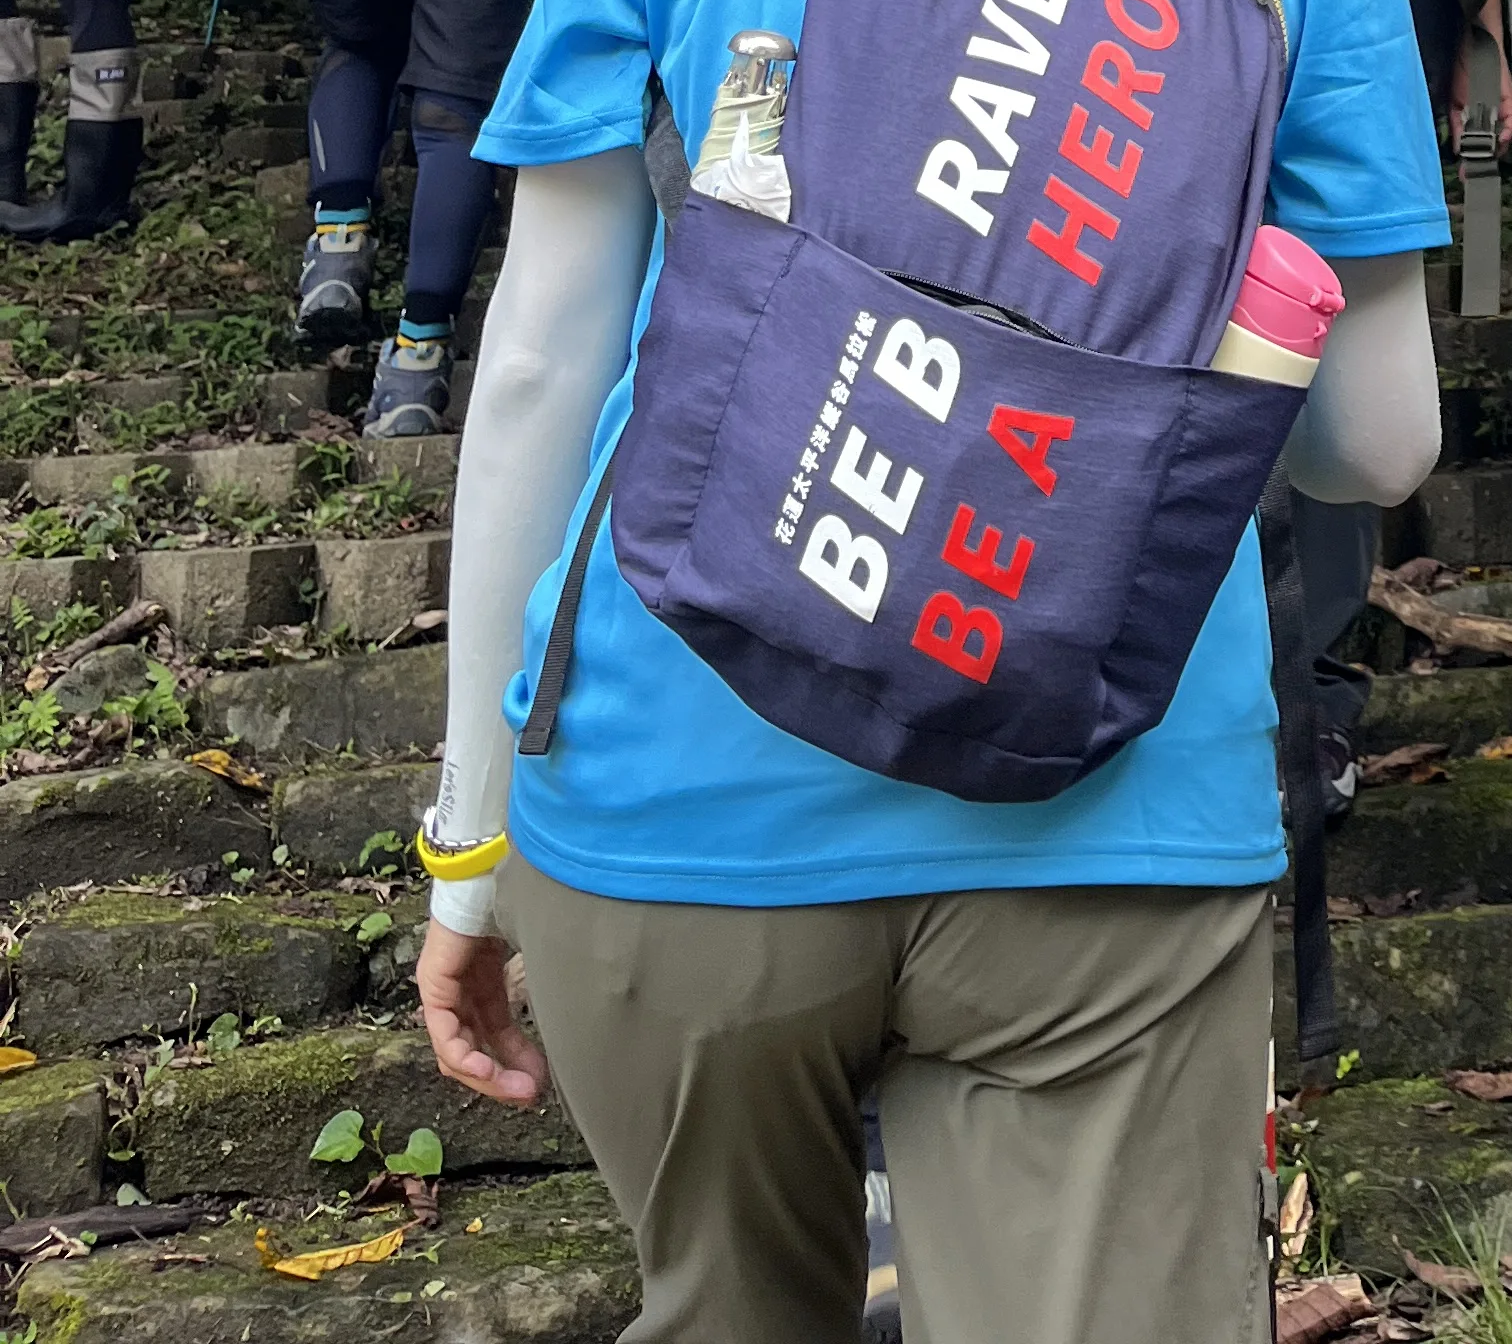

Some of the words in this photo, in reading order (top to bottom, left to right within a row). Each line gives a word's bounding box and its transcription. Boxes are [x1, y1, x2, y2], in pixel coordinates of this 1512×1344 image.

[798, 425, 924, 623] BE
[911, 504, 1036, 683] BE
[987, 405, 1075, 497] A
